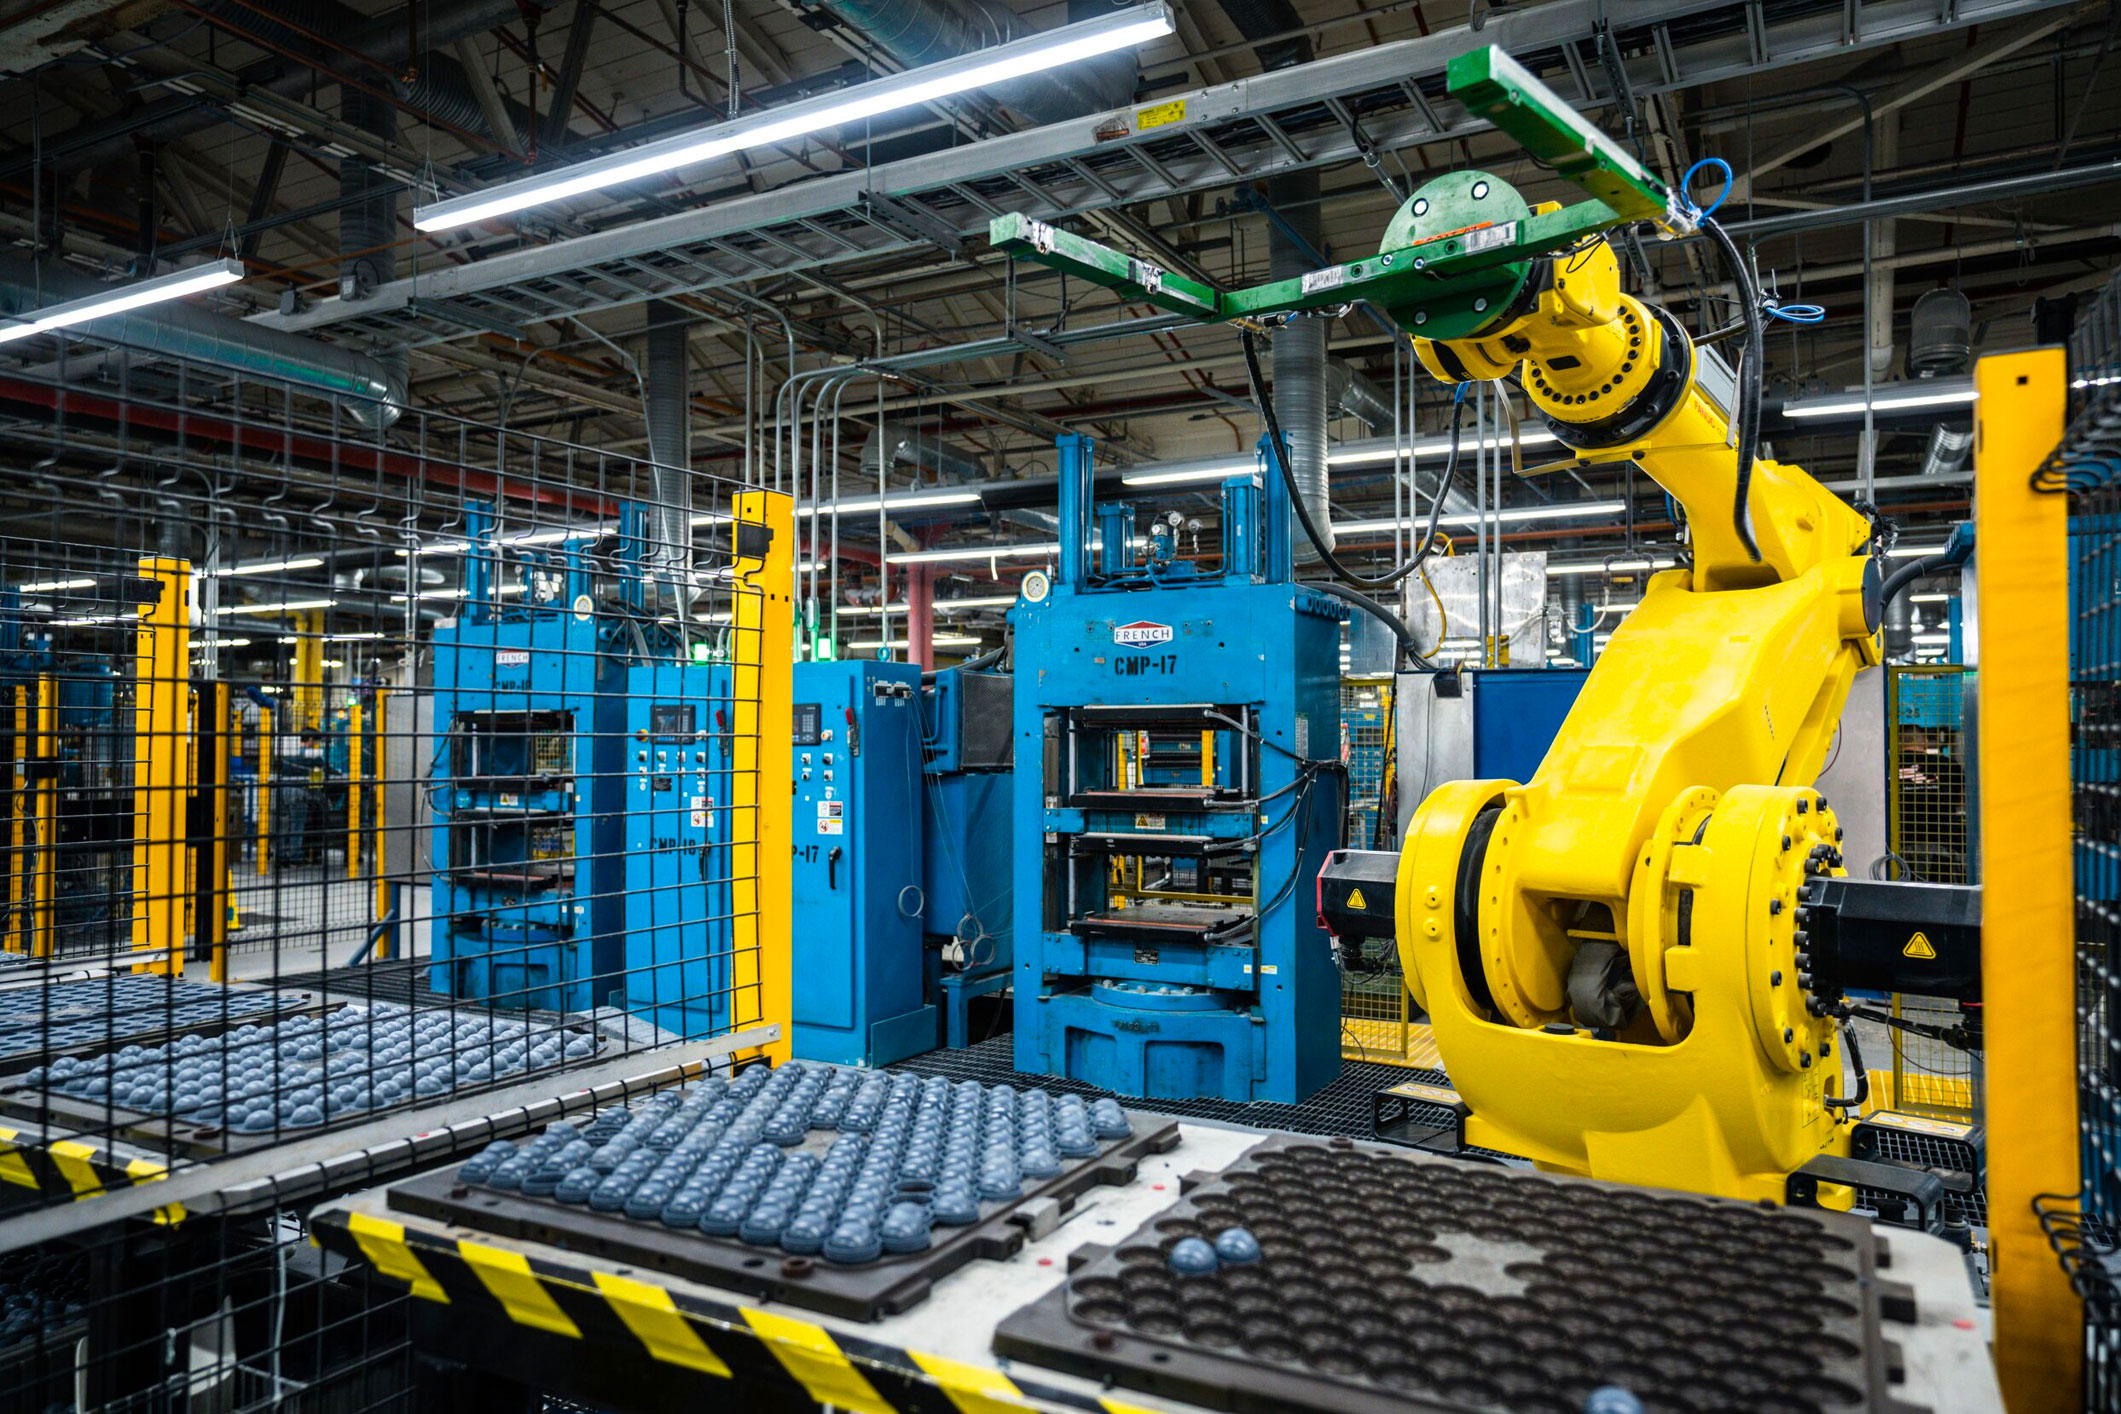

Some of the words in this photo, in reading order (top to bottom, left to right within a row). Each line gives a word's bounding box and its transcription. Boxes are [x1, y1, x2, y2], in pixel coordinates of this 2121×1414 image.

[1115, 629, 1170, 641] FRENCH
[497, 654, 528, 662] FRENCH
[1114, 654, 1177, 676] CMP-17
